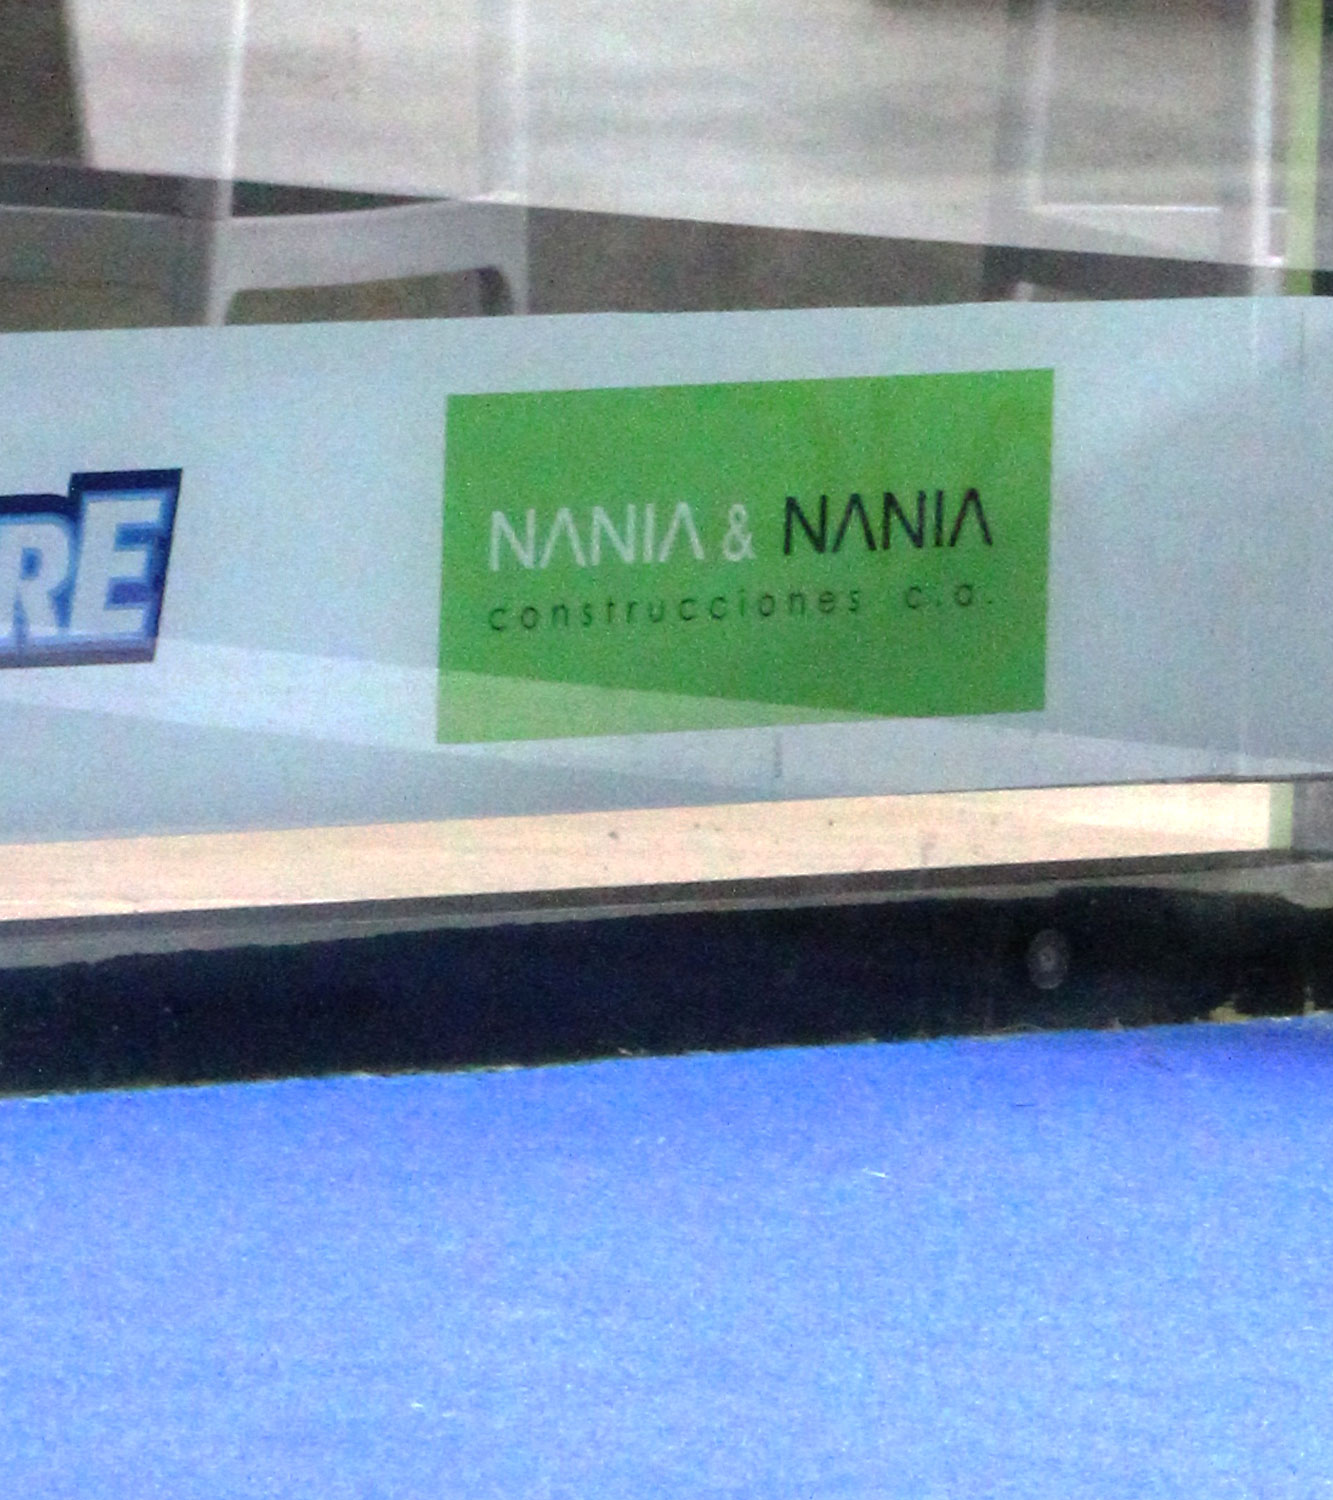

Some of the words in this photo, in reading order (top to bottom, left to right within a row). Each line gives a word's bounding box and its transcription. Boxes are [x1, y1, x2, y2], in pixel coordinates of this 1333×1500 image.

[488, 500, 705, 573] NANIA
[722, 502, 757, 563] &
[783, 487, 994, 557] NANIA
[487, 588, 862, 634] construcciones
